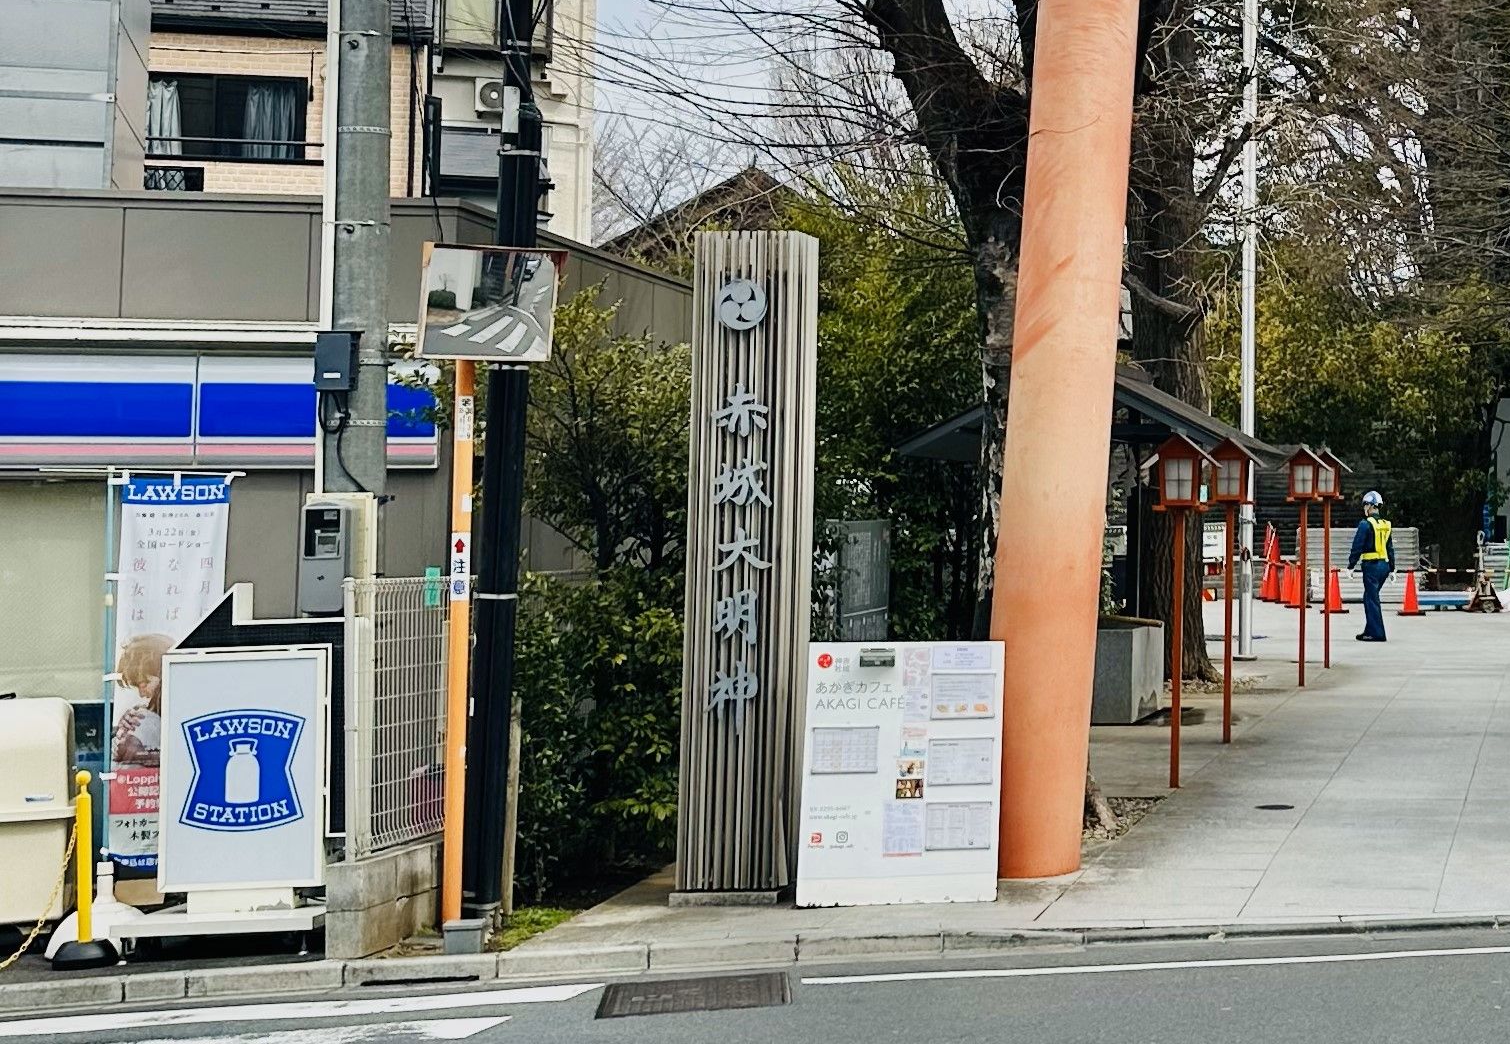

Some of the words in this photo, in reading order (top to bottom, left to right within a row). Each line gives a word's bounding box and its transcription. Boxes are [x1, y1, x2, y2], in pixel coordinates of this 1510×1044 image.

[127, 484, 225, 501] LAWSON
[137, 540, 211, 550] 全国ロードショー
[704, 381, 773, 739] 赤城大明神
[453, 558, 466, 595] 注意
[815, 680, 892, 694] あかぎカフェ
[815, 698, 861, 710] AKAGI
[193, 717, 294, 742] LAWSON
[193, 799, 290, 824] STATION
